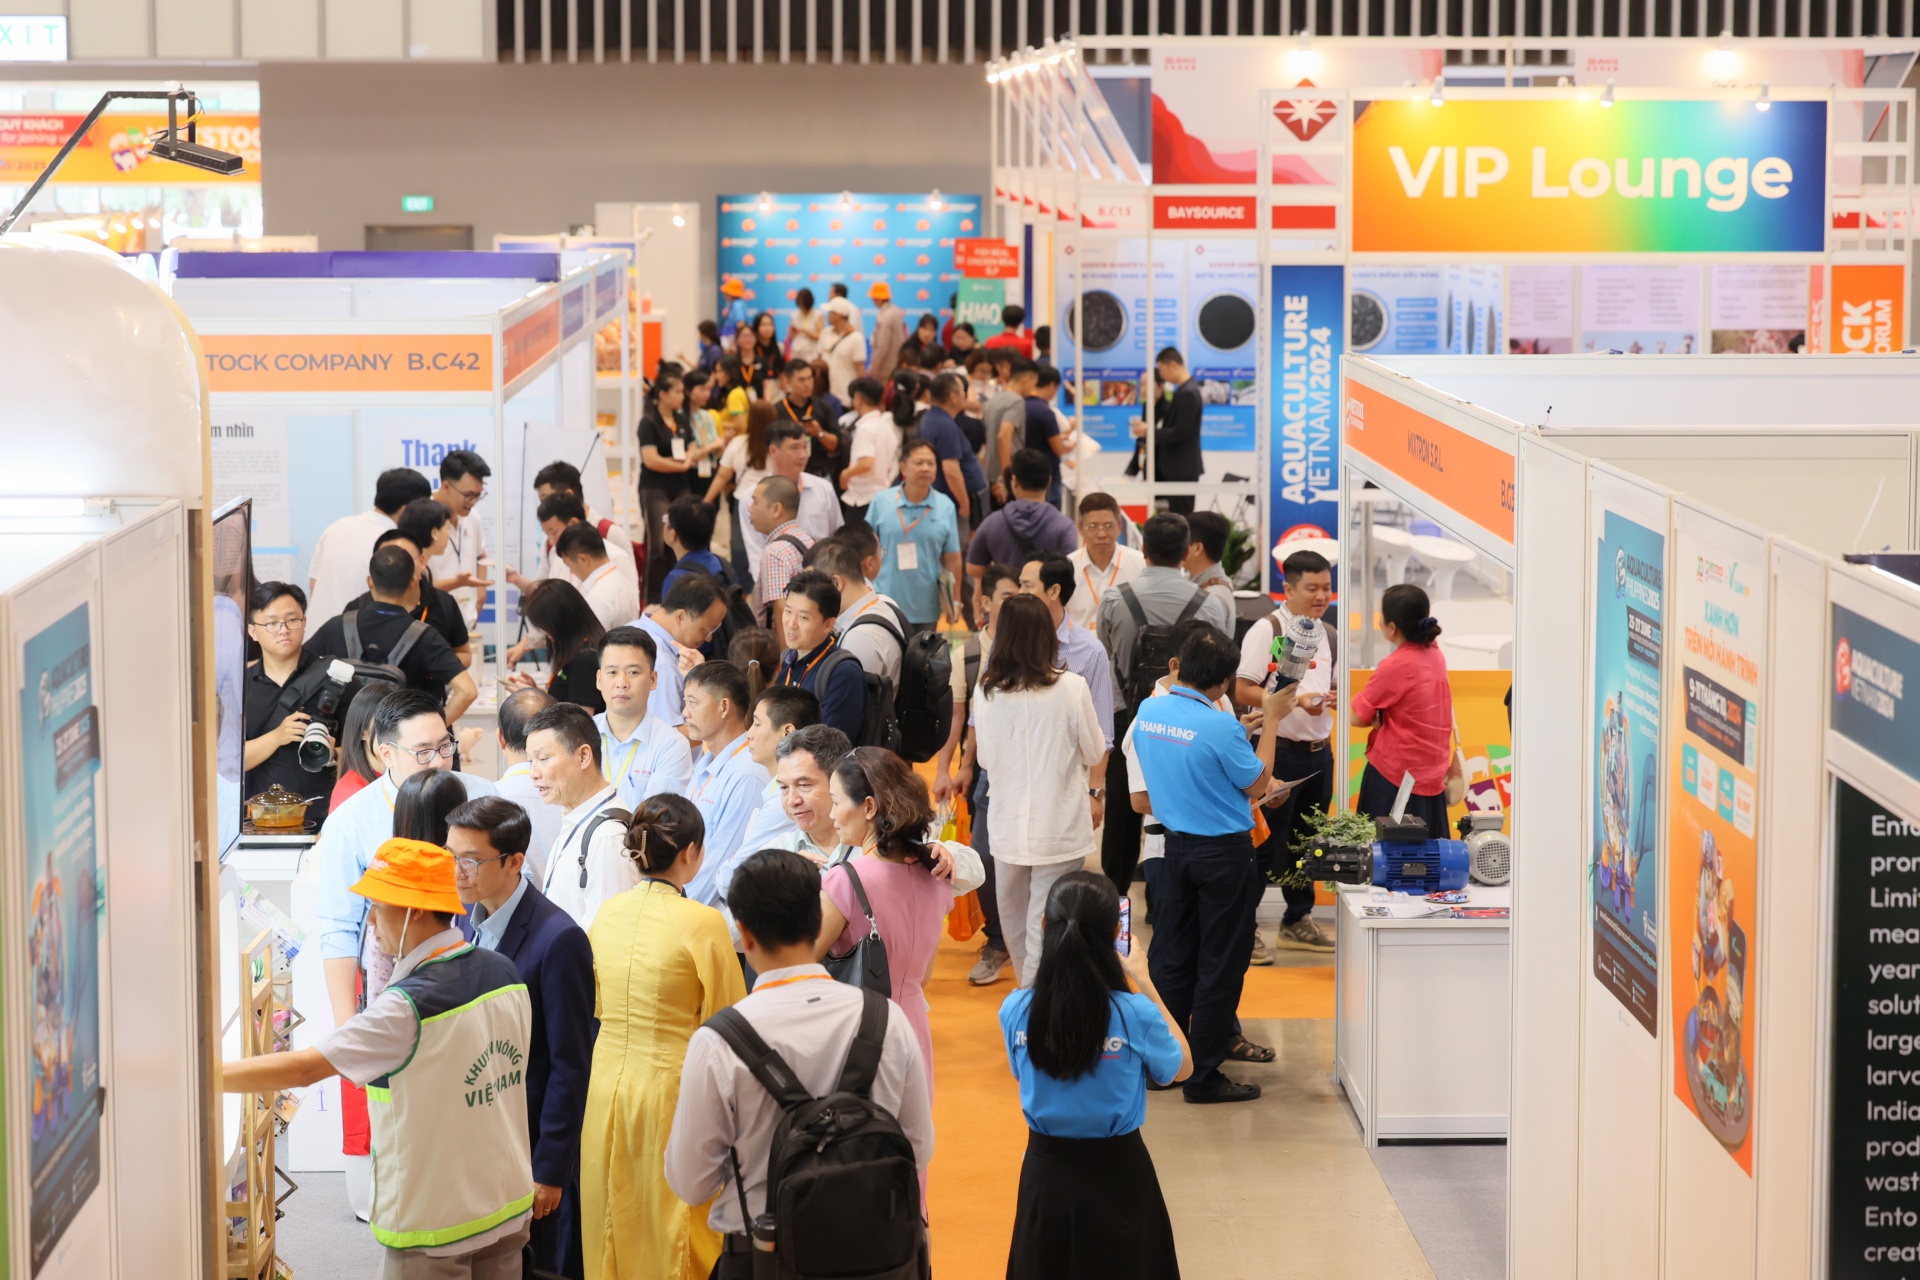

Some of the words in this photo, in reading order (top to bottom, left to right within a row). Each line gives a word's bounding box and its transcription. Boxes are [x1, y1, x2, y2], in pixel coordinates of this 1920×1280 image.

[1388, 146, 1509, 198] VIP
[1531, 146, 1793, 212] Lounge
[1168, 206, 1245, 220] BAYSOURCE
[959, 302, 1001, 326] HMO
[274, 353, 393, 371] COMPANY
[408, 352, 480, 371] B.C42
[1281, 295, 1309, 504] AQUACULTURE
[1626, 553, 1662, 590] AQUACULTURE
[1851, 648, 1904, 700] AQUACULTURE
[1139, 720, 1166, 736] THANH
[1167, 725, 1197, 741] HUNG
[496, 1039, 523, 1066] NÔNG
[465, 1082, 496, 1107] VIỆ
[1865, 1206, 1918, 1227] Ento
